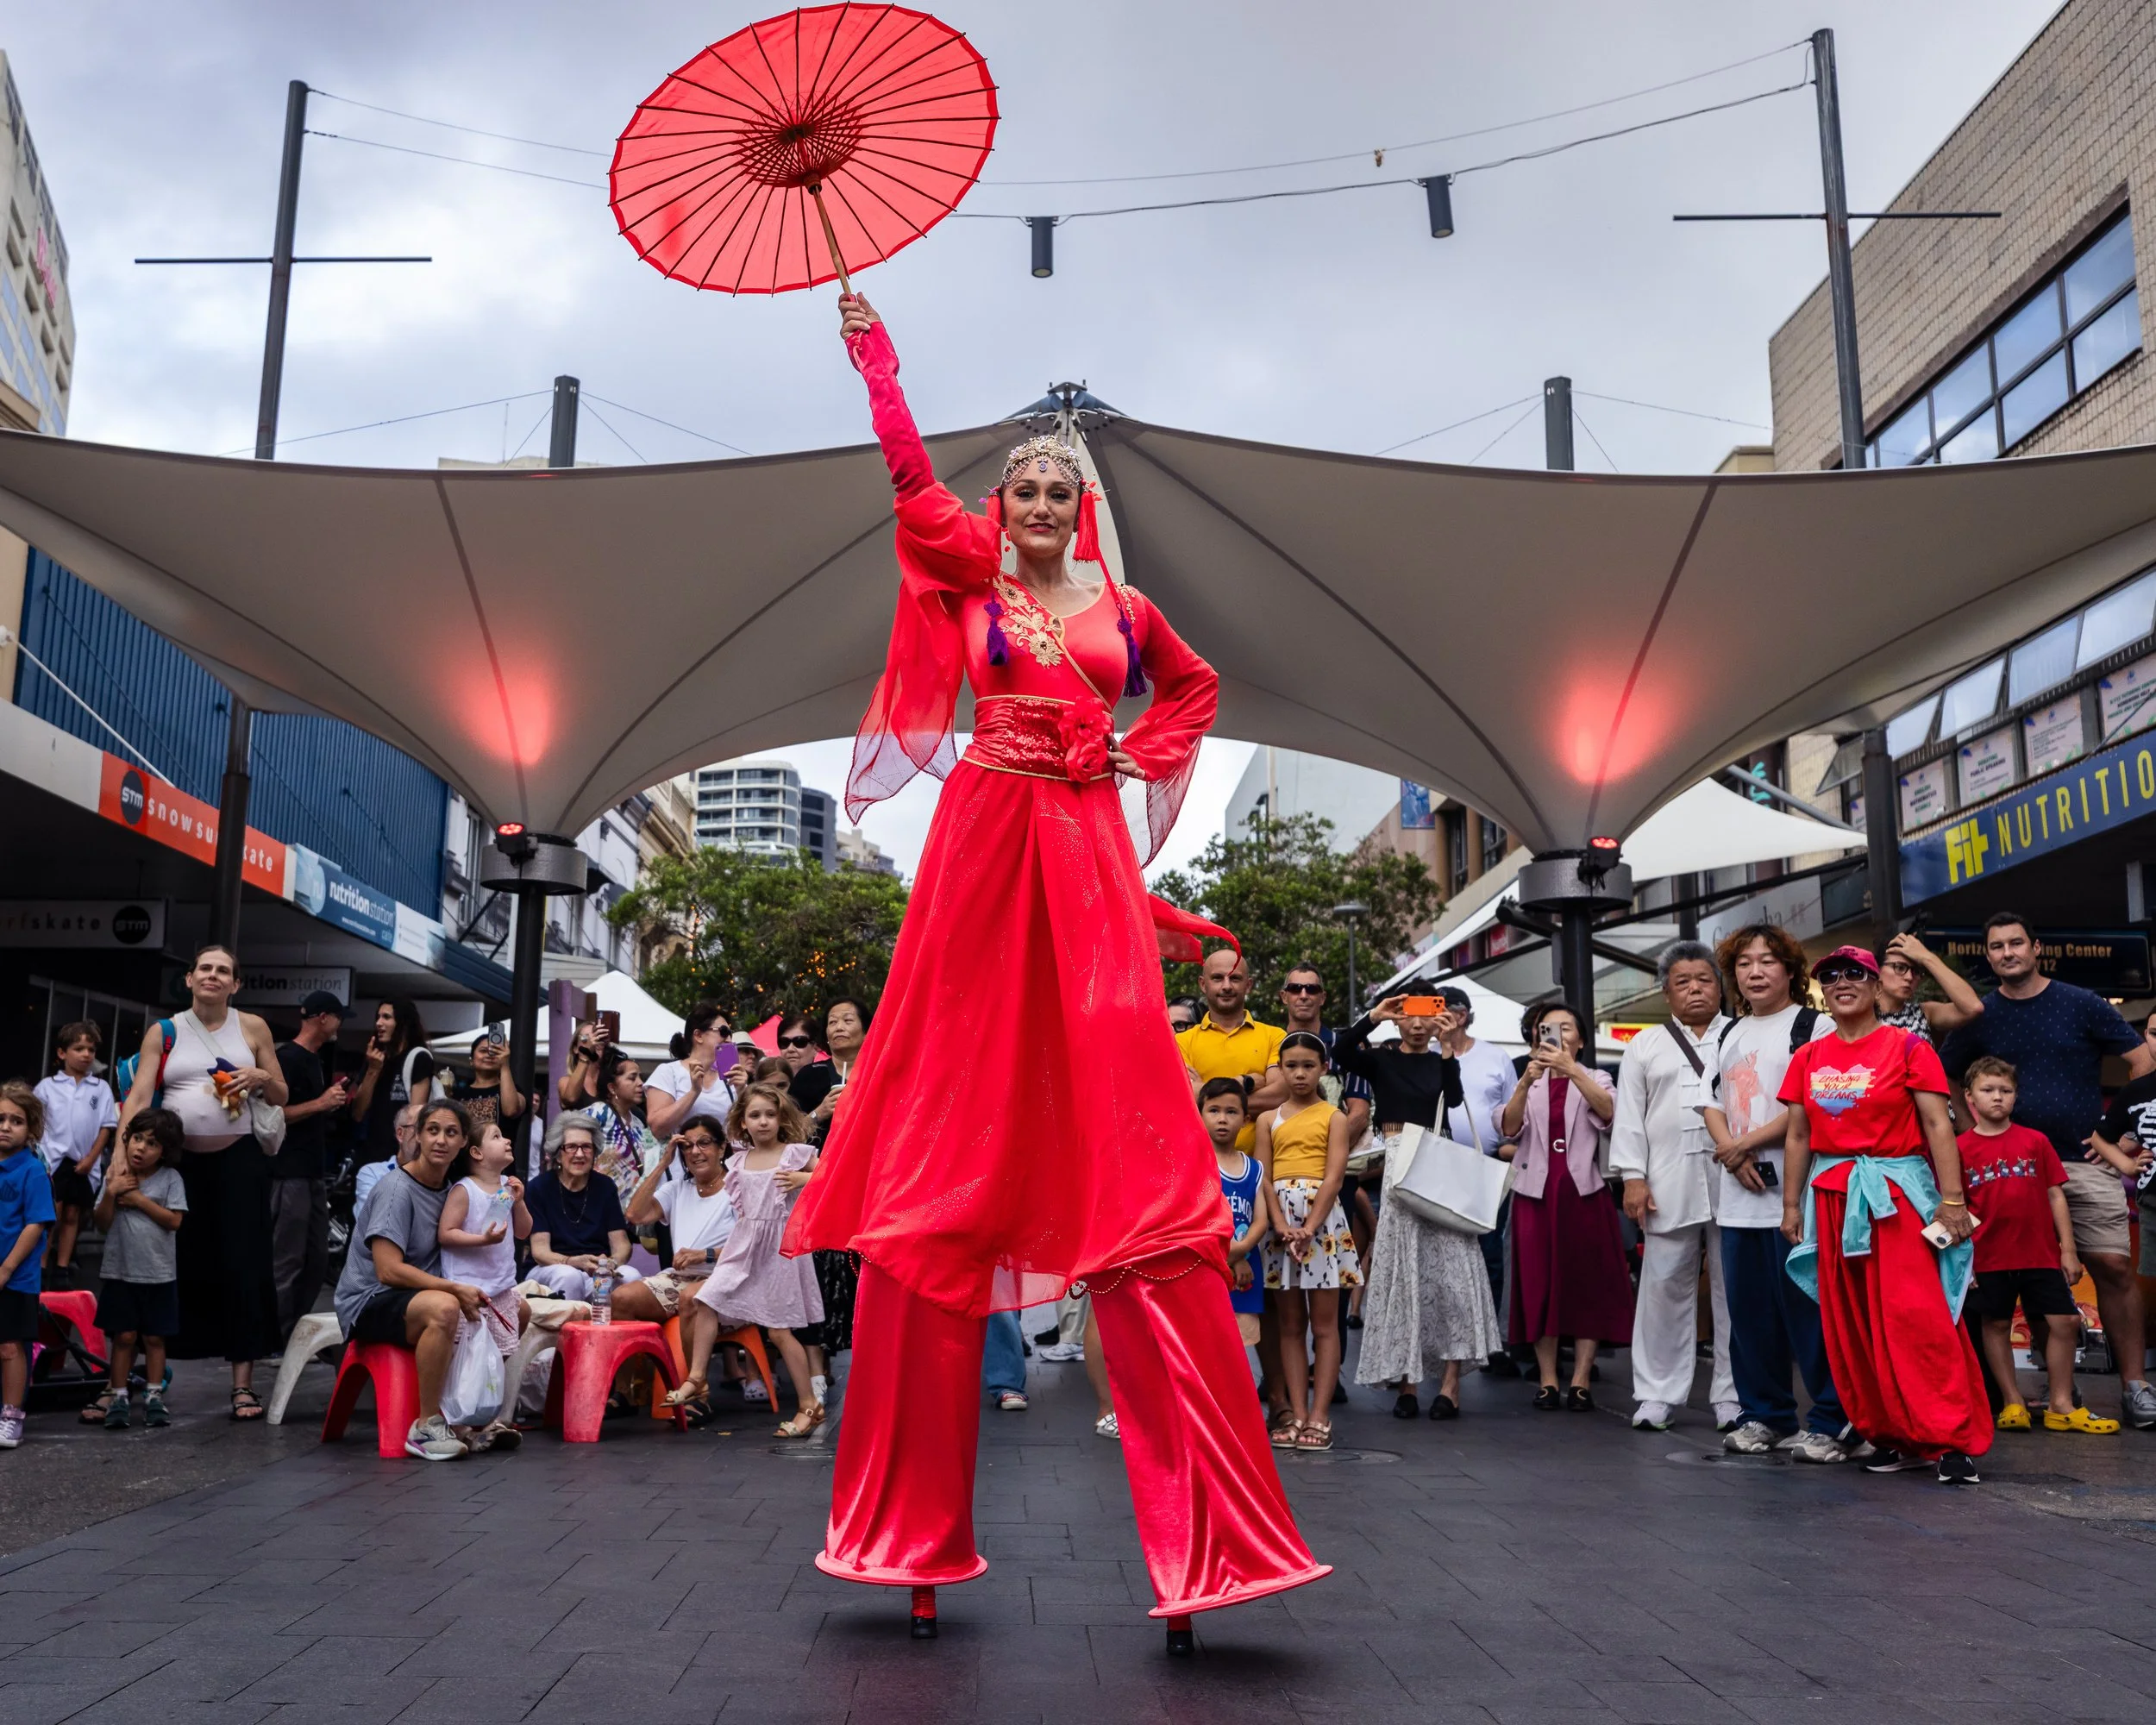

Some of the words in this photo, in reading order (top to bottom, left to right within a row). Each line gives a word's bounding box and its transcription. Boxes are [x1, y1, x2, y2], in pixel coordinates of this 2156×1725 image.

[1996, 750, 2155, 857] NUTRITIO
[329, 881, 370, 916] nutrition
[370, 902, 394, 927] station
[2066, 942, 2113, 958] Center
[290, 973, 342, 991] station
[1818, 1075, 1861, 1083] CHASING
[1823, 1082, 1852, 1091] YOUR
[1814, 1091, 1858, 1101] DREAMS
